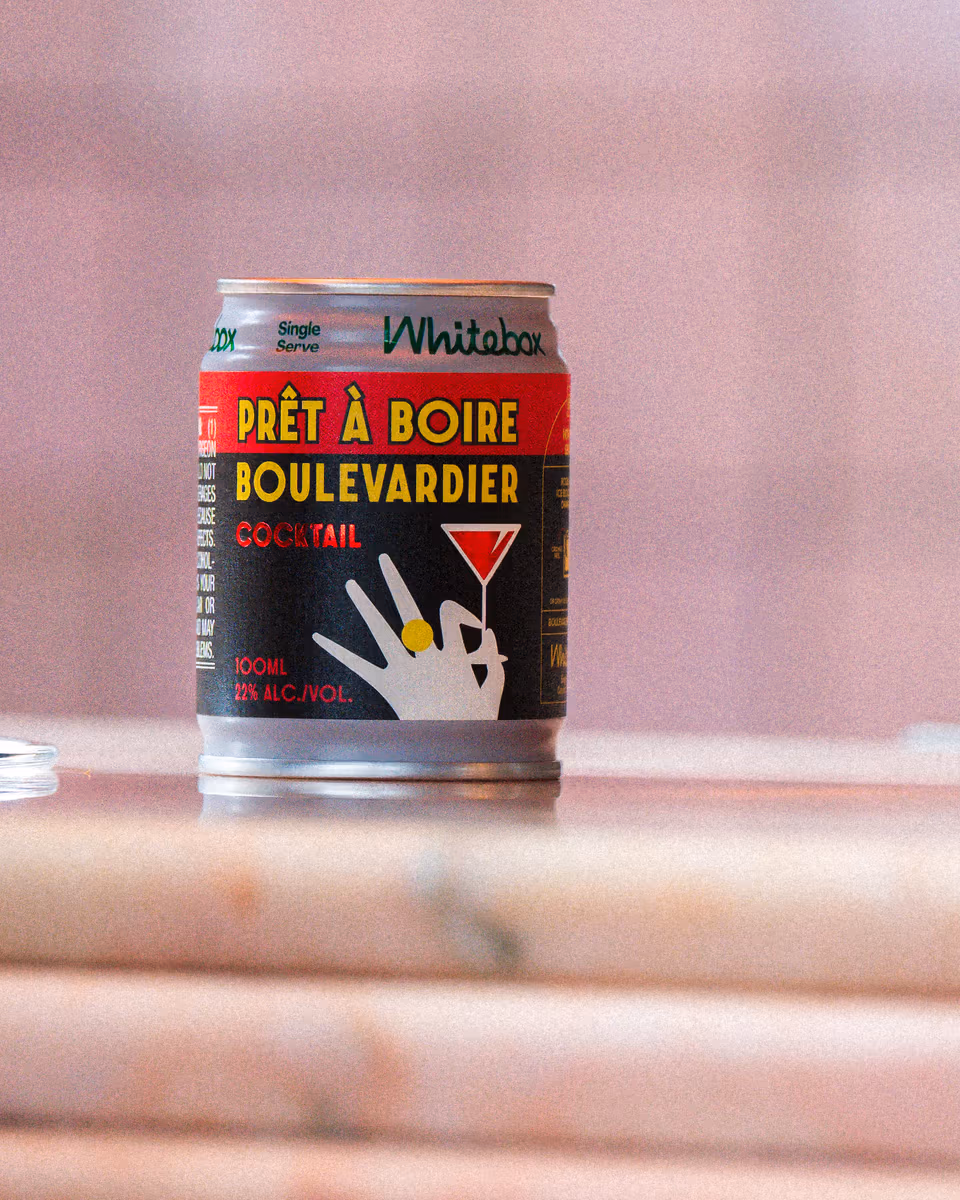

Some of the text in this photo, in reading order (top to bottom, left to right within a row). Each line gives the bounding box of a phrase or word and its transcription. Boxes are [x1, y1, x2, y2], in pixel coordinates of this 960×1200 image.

[278, 321, 321, 339] Single
[384, 315, 546, 356] Whitebox
[276, 340, 320, 353] Serve
[237, 381, 327, 445] PRÊT
[339, 381, 374, 445] À
[389, 397, 520, 446] BOIRE
[236, 461, 519, 503] BOULEVARDIER
[235, 521, 362, 548] COCKTAIL
[235, 656, 288, 676] 100ML
[234, 683, 354, 703] 22% ALC./VOL.
